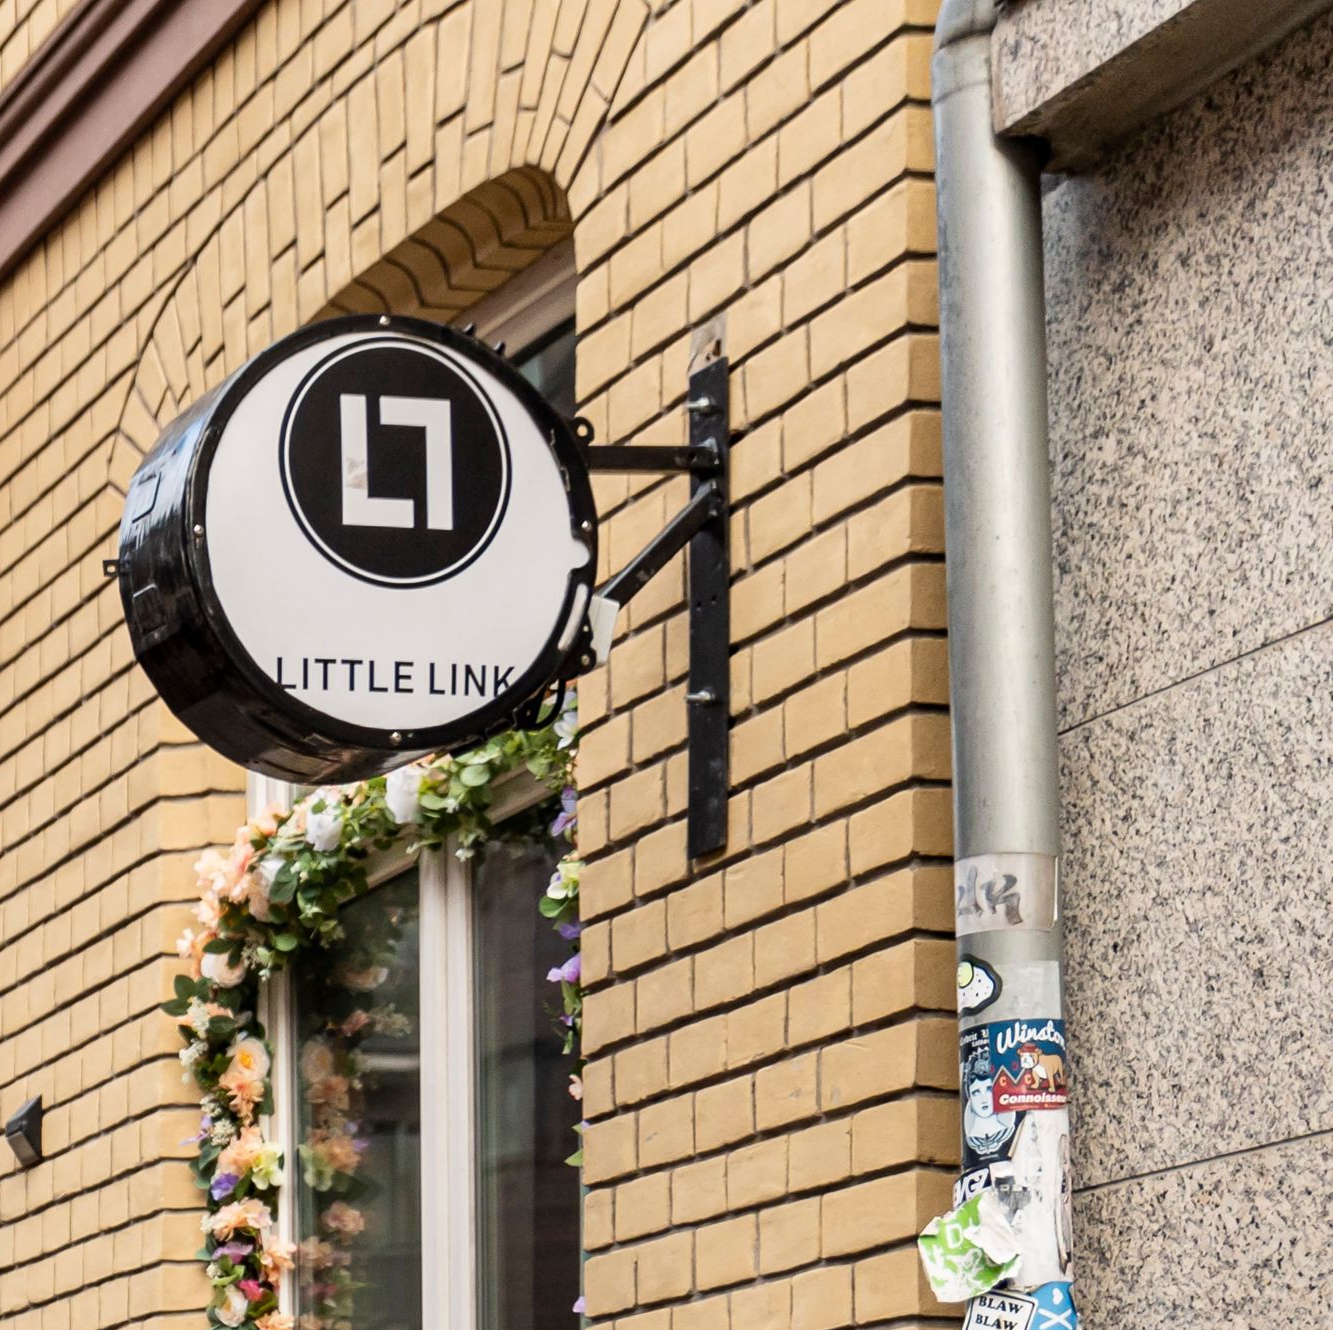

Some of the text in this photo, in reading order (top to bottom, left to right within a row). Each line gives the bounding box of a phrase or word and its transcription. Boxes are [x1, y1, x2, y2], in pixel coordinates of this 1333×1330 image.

[276, 656, 516, 698] LITTLE LINK
[978, 1296, 1024, 1315] BLAW
